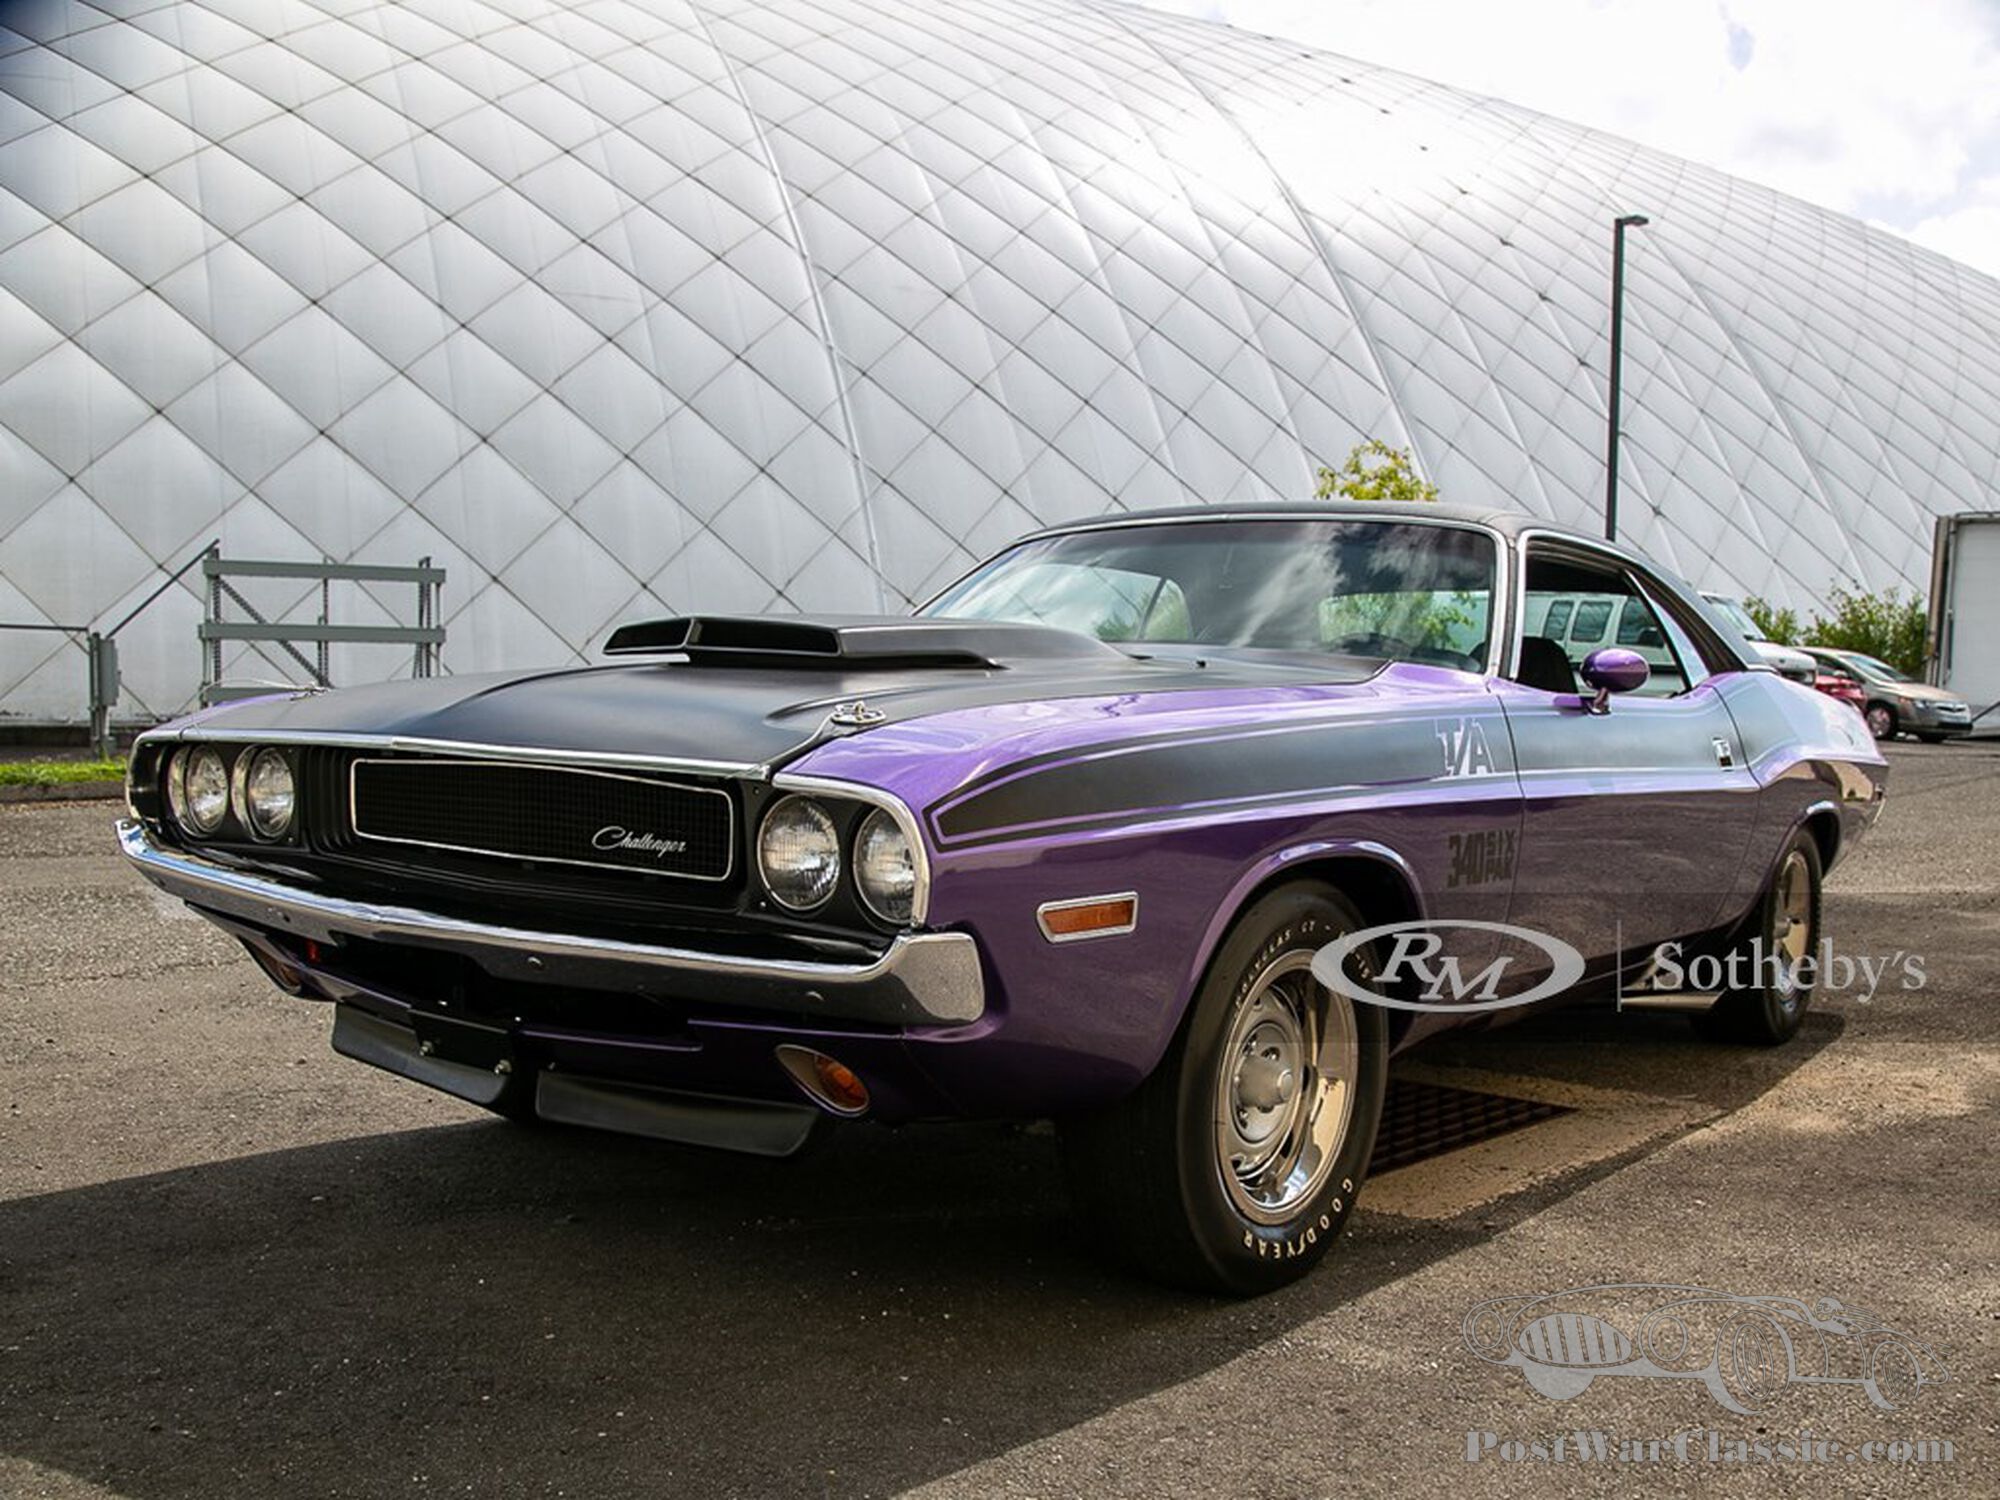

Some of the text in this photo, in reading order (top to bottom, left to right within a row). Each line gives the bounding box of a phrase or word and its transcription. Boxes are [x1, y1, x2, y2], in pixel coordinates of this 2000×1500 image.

[591, 825, 687, 858] Challenger
[1447, 829, 1516, 888] 340 SIX
[1243, 1178, 1354, 1259] GOODYEAR
